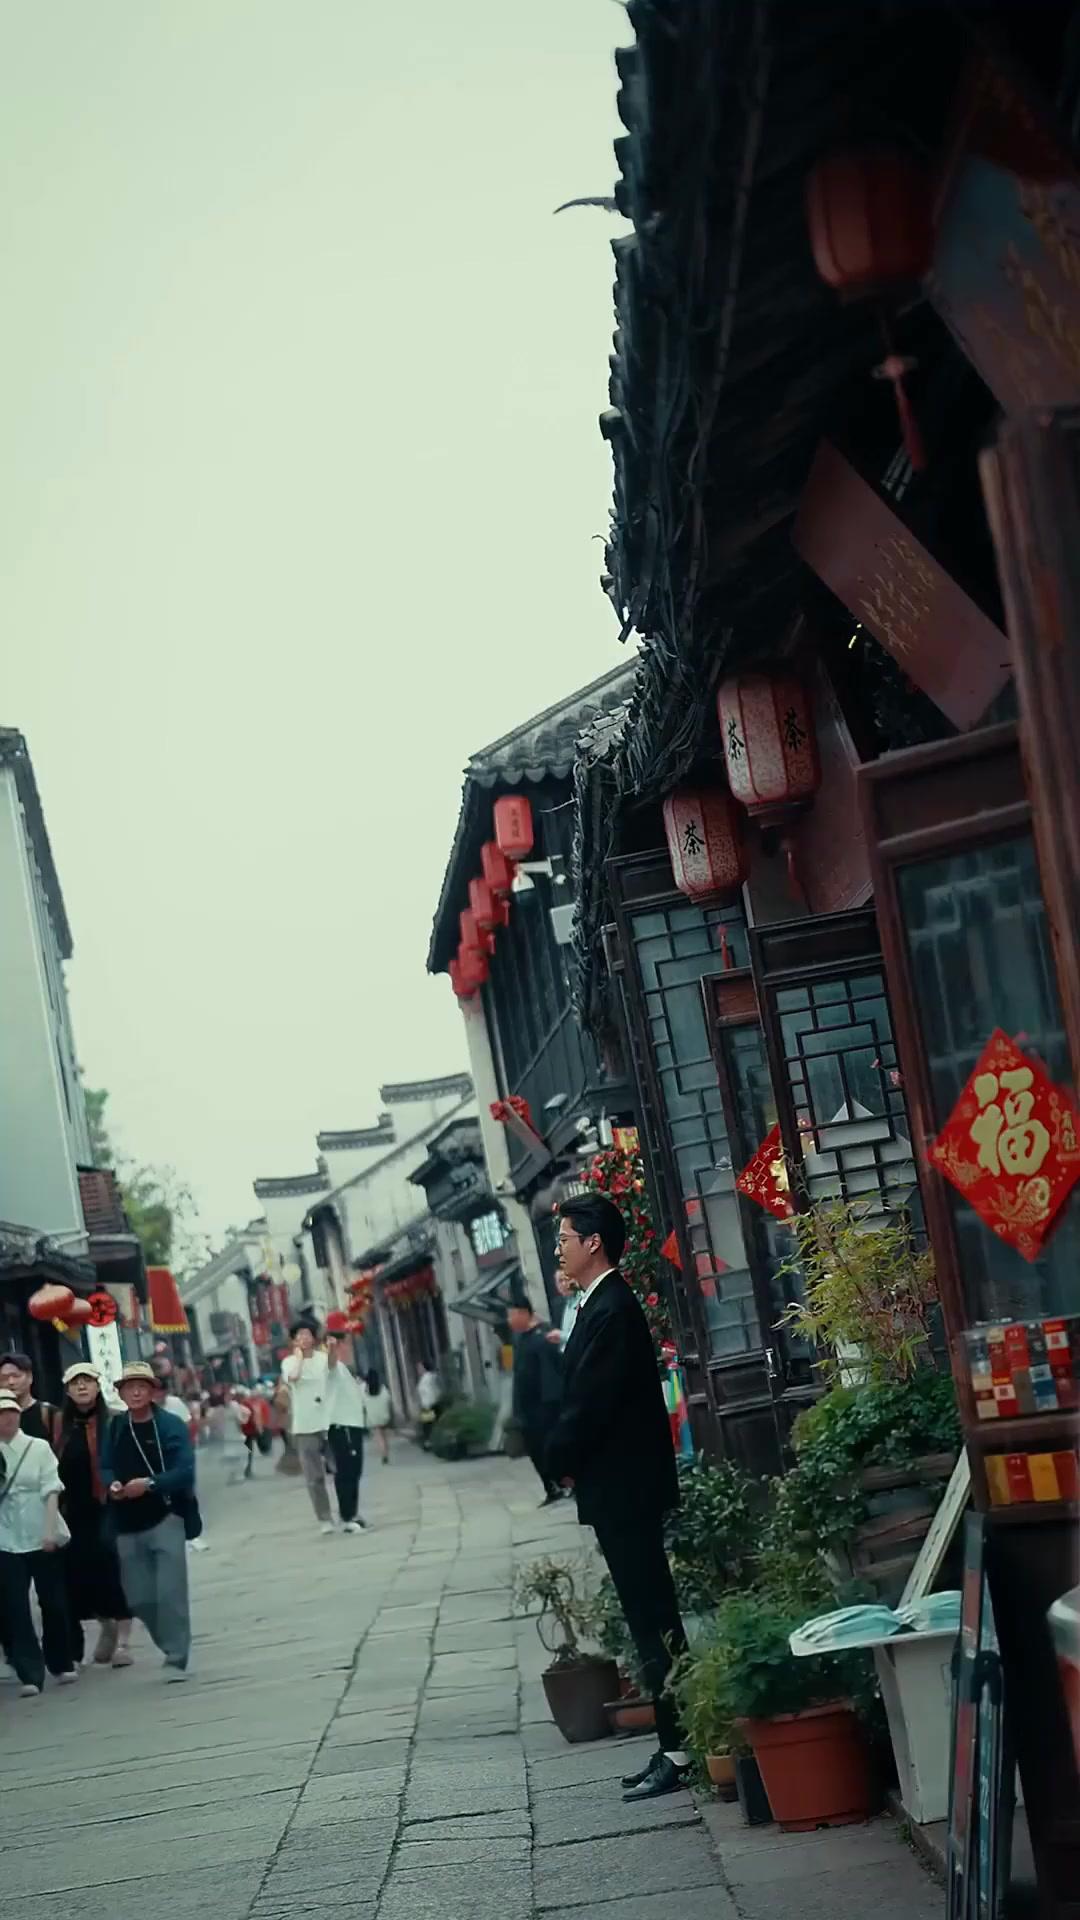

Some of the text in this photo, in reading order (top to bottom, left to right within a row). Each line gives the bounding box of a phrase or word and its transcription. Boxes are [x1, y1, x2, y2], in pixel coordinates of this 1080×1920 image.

[728, 719, 745, 760] 茶
[783, 707, 806, 750] 茶
[683, 820, 704, 855] 茶
[970, 1066, 1050, 1176] 福
